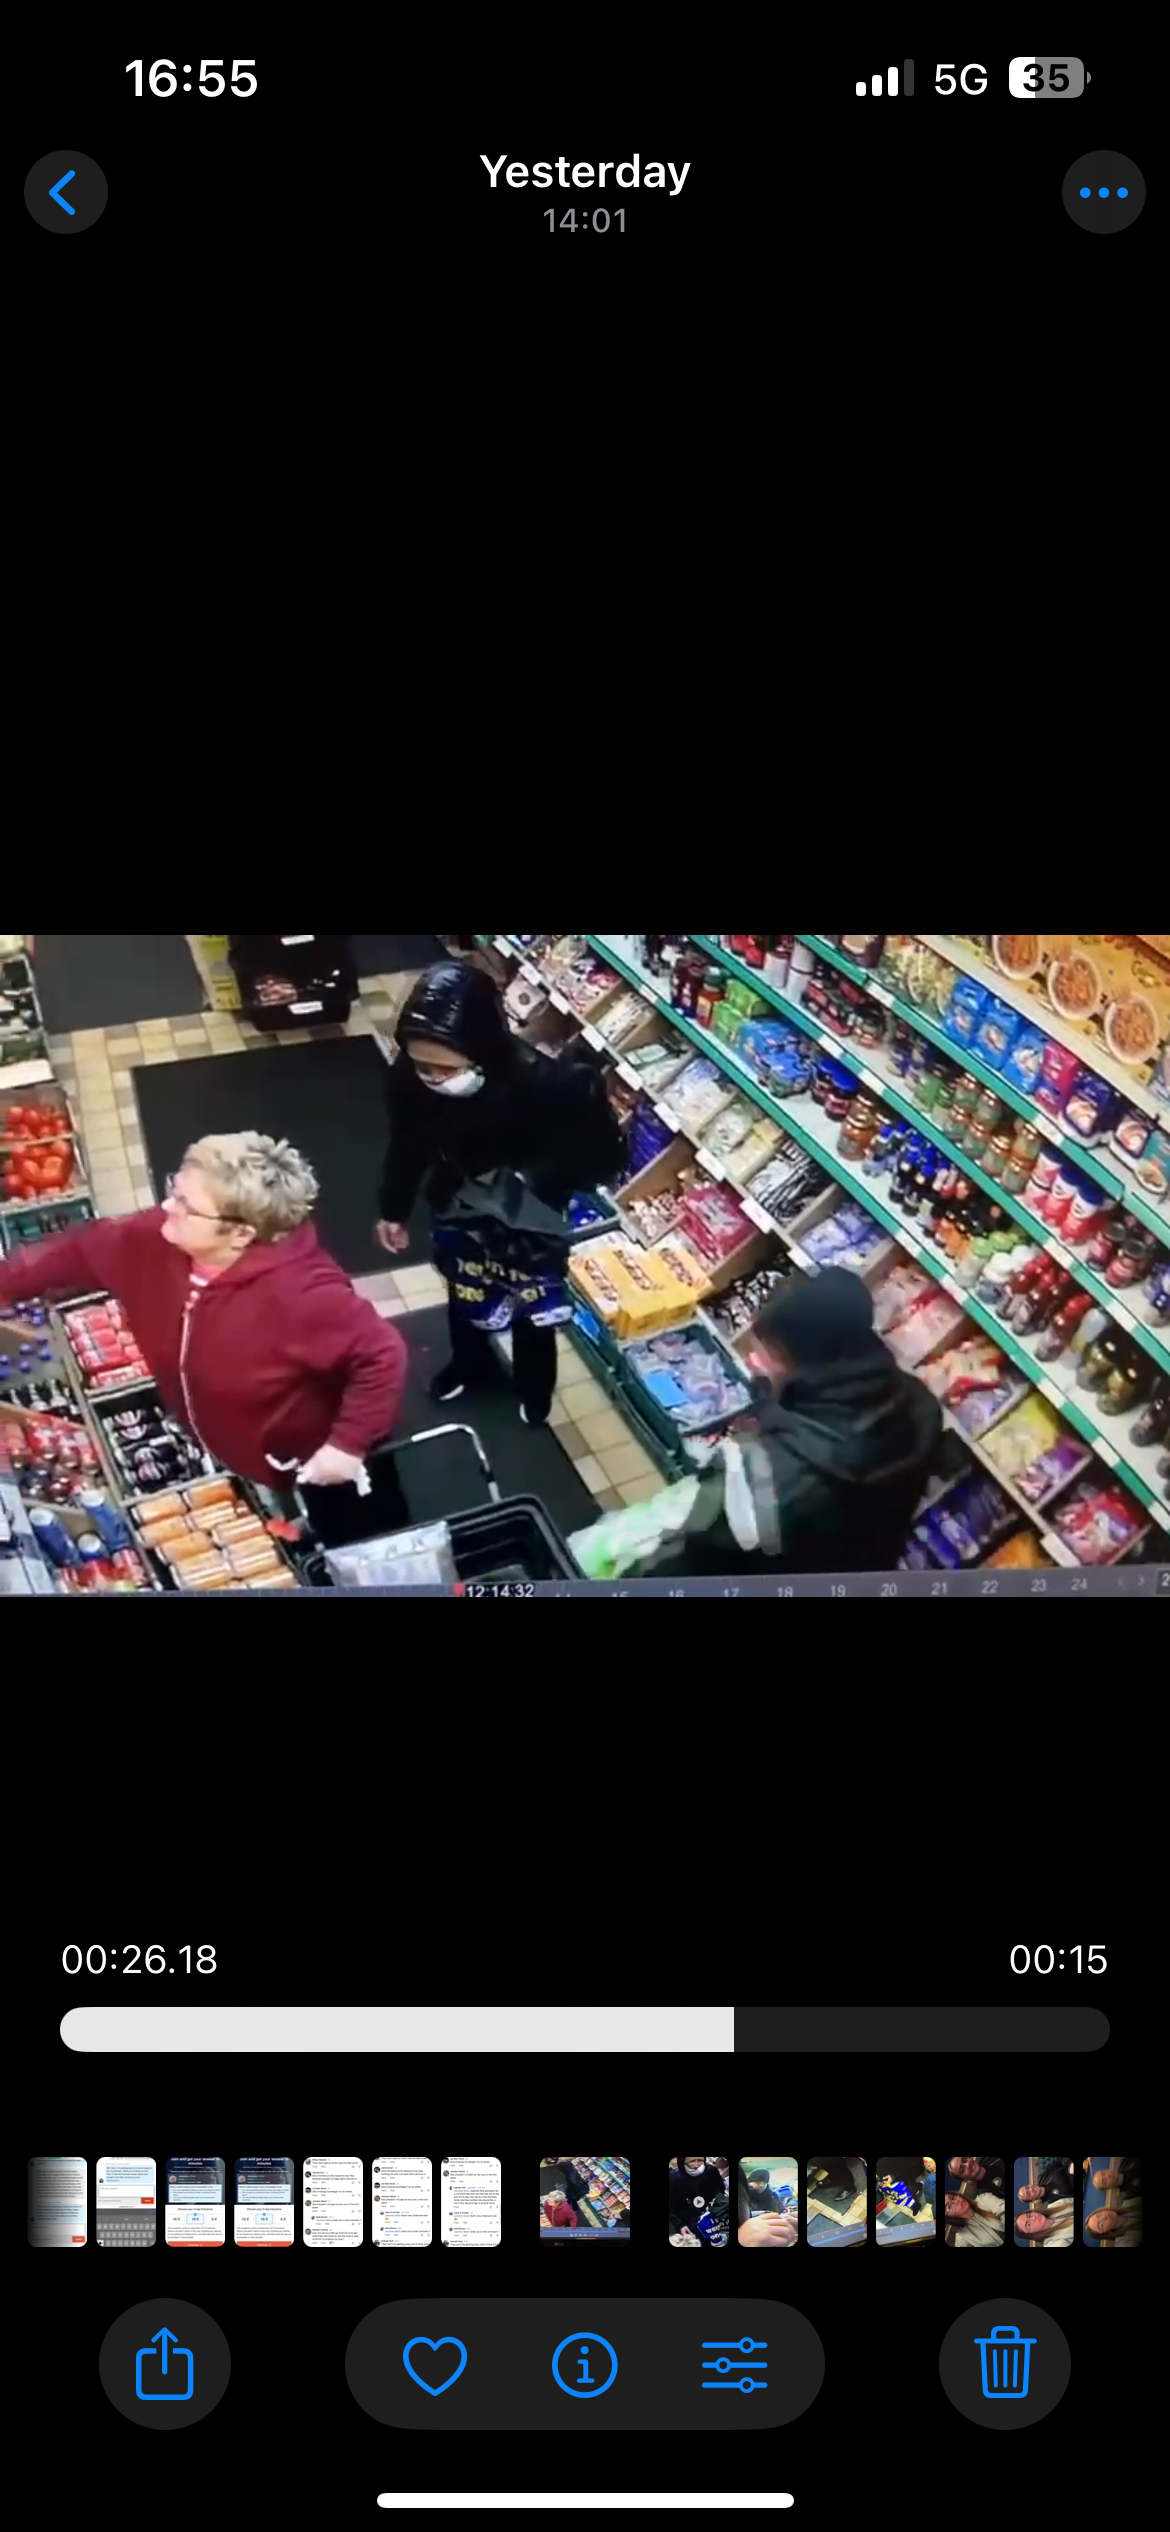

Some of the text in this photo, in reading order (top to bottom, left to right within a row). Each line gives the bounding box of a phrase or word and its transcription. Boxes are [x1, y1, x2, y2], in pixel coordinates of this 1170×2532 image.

[126, 59, 257, 97] 16:55
[935, 63, 987, 95] 5G
[1023, 63, 1069, 92] 35
[480, 153, 691, 196] Yesterday
[543, 207, 627, 233] 14:01
[466, 1583, 535, 1598] 12:14:32
[724, 1587, 740, 1598] 17
[777, 1586, 794, 1598] 18
[830, 1584, 847, 1598] 19
[880, 1583, 898, 1597] 20
[931, 1581, 949, 1595] 21
[981, 1580, 1000, 1594] 22
[1031, 1579, 1047, 1593] 23
[1071, 1577, 1088, 1591] 24
[62, 1945, 217, 1974] 00:26.18
[1010, 1945, 1107, 1974] 00:15
